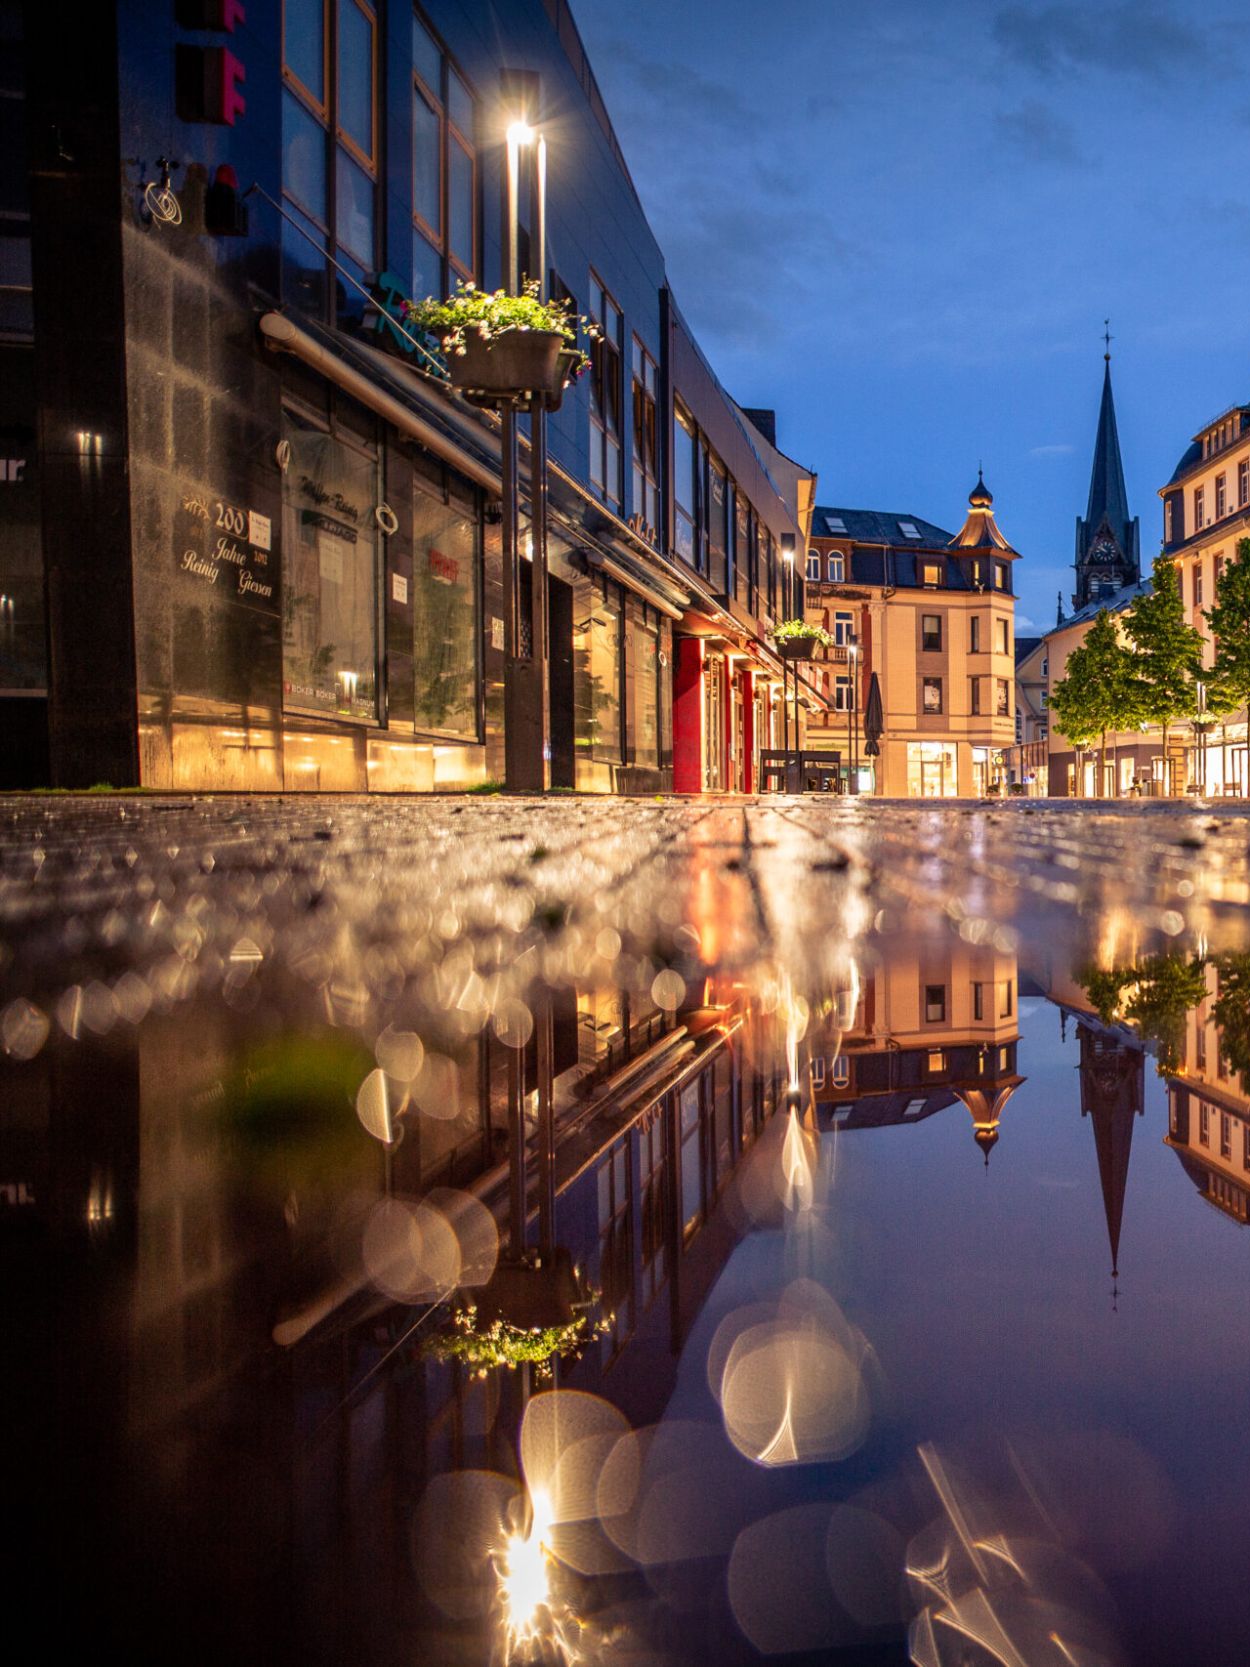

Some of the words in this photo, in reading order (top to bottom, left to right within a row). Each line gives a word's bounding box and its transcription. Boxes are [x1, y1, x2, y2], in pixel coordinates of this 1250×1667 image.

[216, 503, 244, 534] 200
[181, 550, 219, 584] Reinig
[212, 537, 247, 566] Jahre
